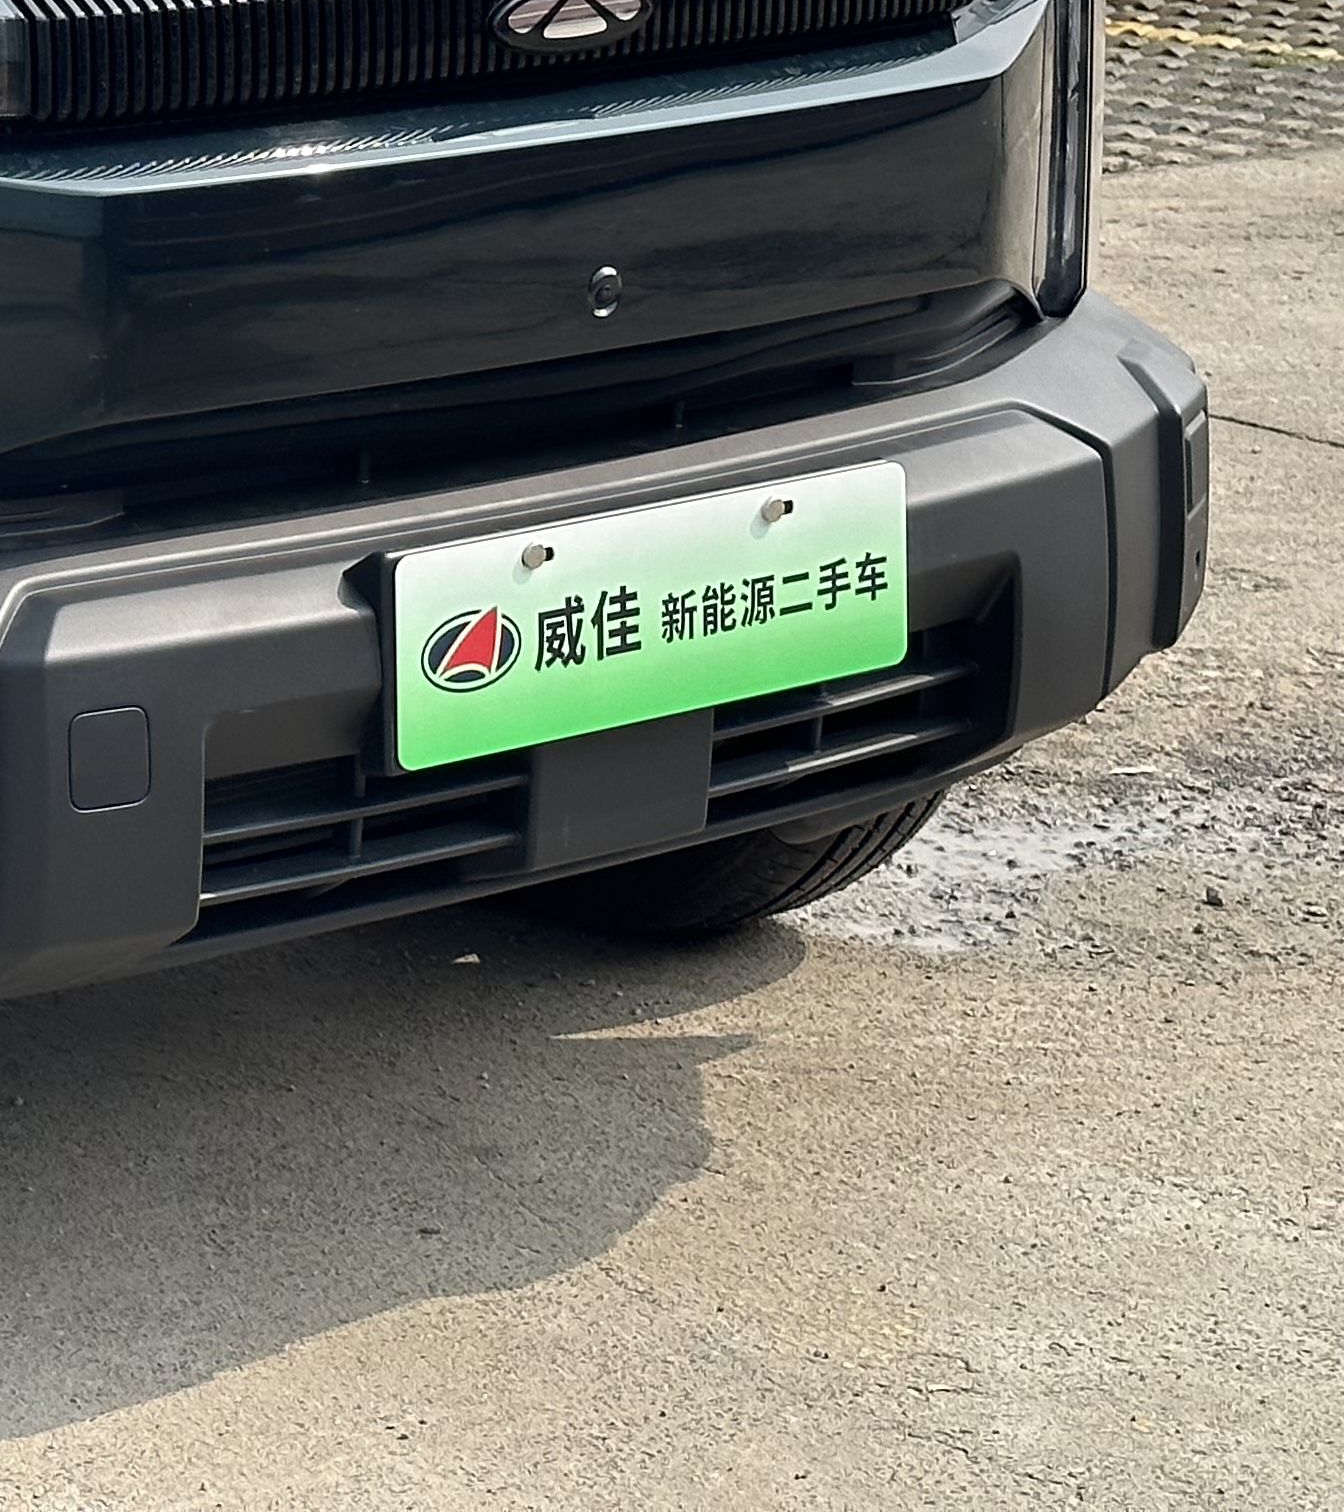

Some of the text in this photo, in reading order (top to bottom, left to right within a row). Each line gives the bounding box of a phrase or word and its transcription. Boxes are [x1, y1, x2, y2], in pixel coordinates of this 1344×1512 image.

[534, 551, 890, 672] 威佳 新能源二手车
